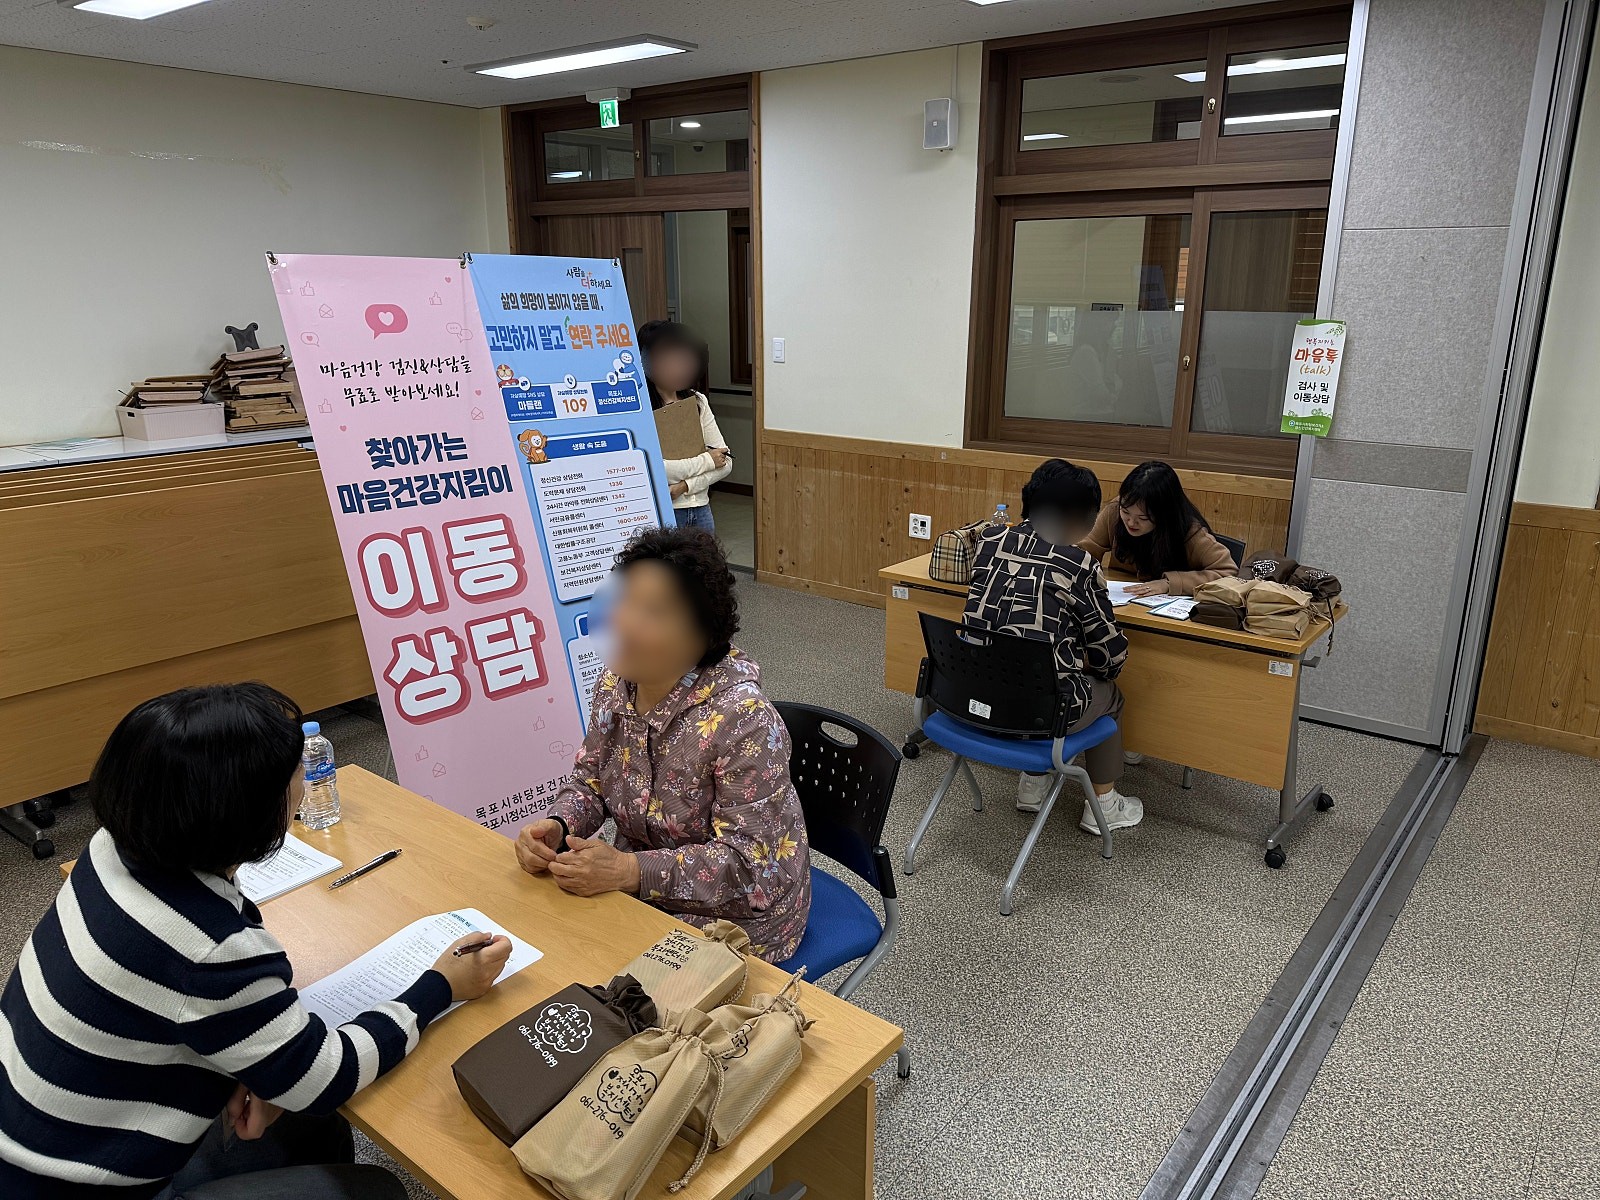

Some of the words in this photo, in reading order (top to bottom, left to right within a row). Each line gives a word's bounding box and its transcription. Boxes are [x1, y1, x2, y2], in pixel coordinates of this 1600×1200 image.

[566, 266, 586, 278] 사람을
[581, 276, 612, 289] 더하세요
[500, 292, 520, 311] 삶의
[520, 292, 546, 311] 희망이
[546, 293, 572, 311] 보이지
[572, 293, 589, 311] 않을
[486, 324, 539, 351] 고민하지
[538, 324, 566, 351] 말고
[567, 324, 594, 350] 연락
[594, 322, 634, 349] 주세요
[319, 359, 383, 379] 마음건강
[388, 355, 472, 376] 검진&상담을
[1294, 347, 1339, 364] 마음톡
[1299, 364, 1332, 376] (talk)
[343, 386, 381, 407] 무료로
[384, 380, 460, 403] 받아보세요!
[1293, 392, 1331, 404] 이동상담
[1298, 381, 1317, 392] 검사
[1320, 381, 1329, 393] 및
[562, 397, 588, 413] 109
[364, 431, 469, 471] 찾아가는
[336, 464, 514, 515] 마음건강지킴이
[358, 514, 526, 616] 이동
[384, 608, 547, 722] 상담
[518, 1025, 558, 1068] 061-276-0199
[579, 1095, 625, 1140] 061-276-019
